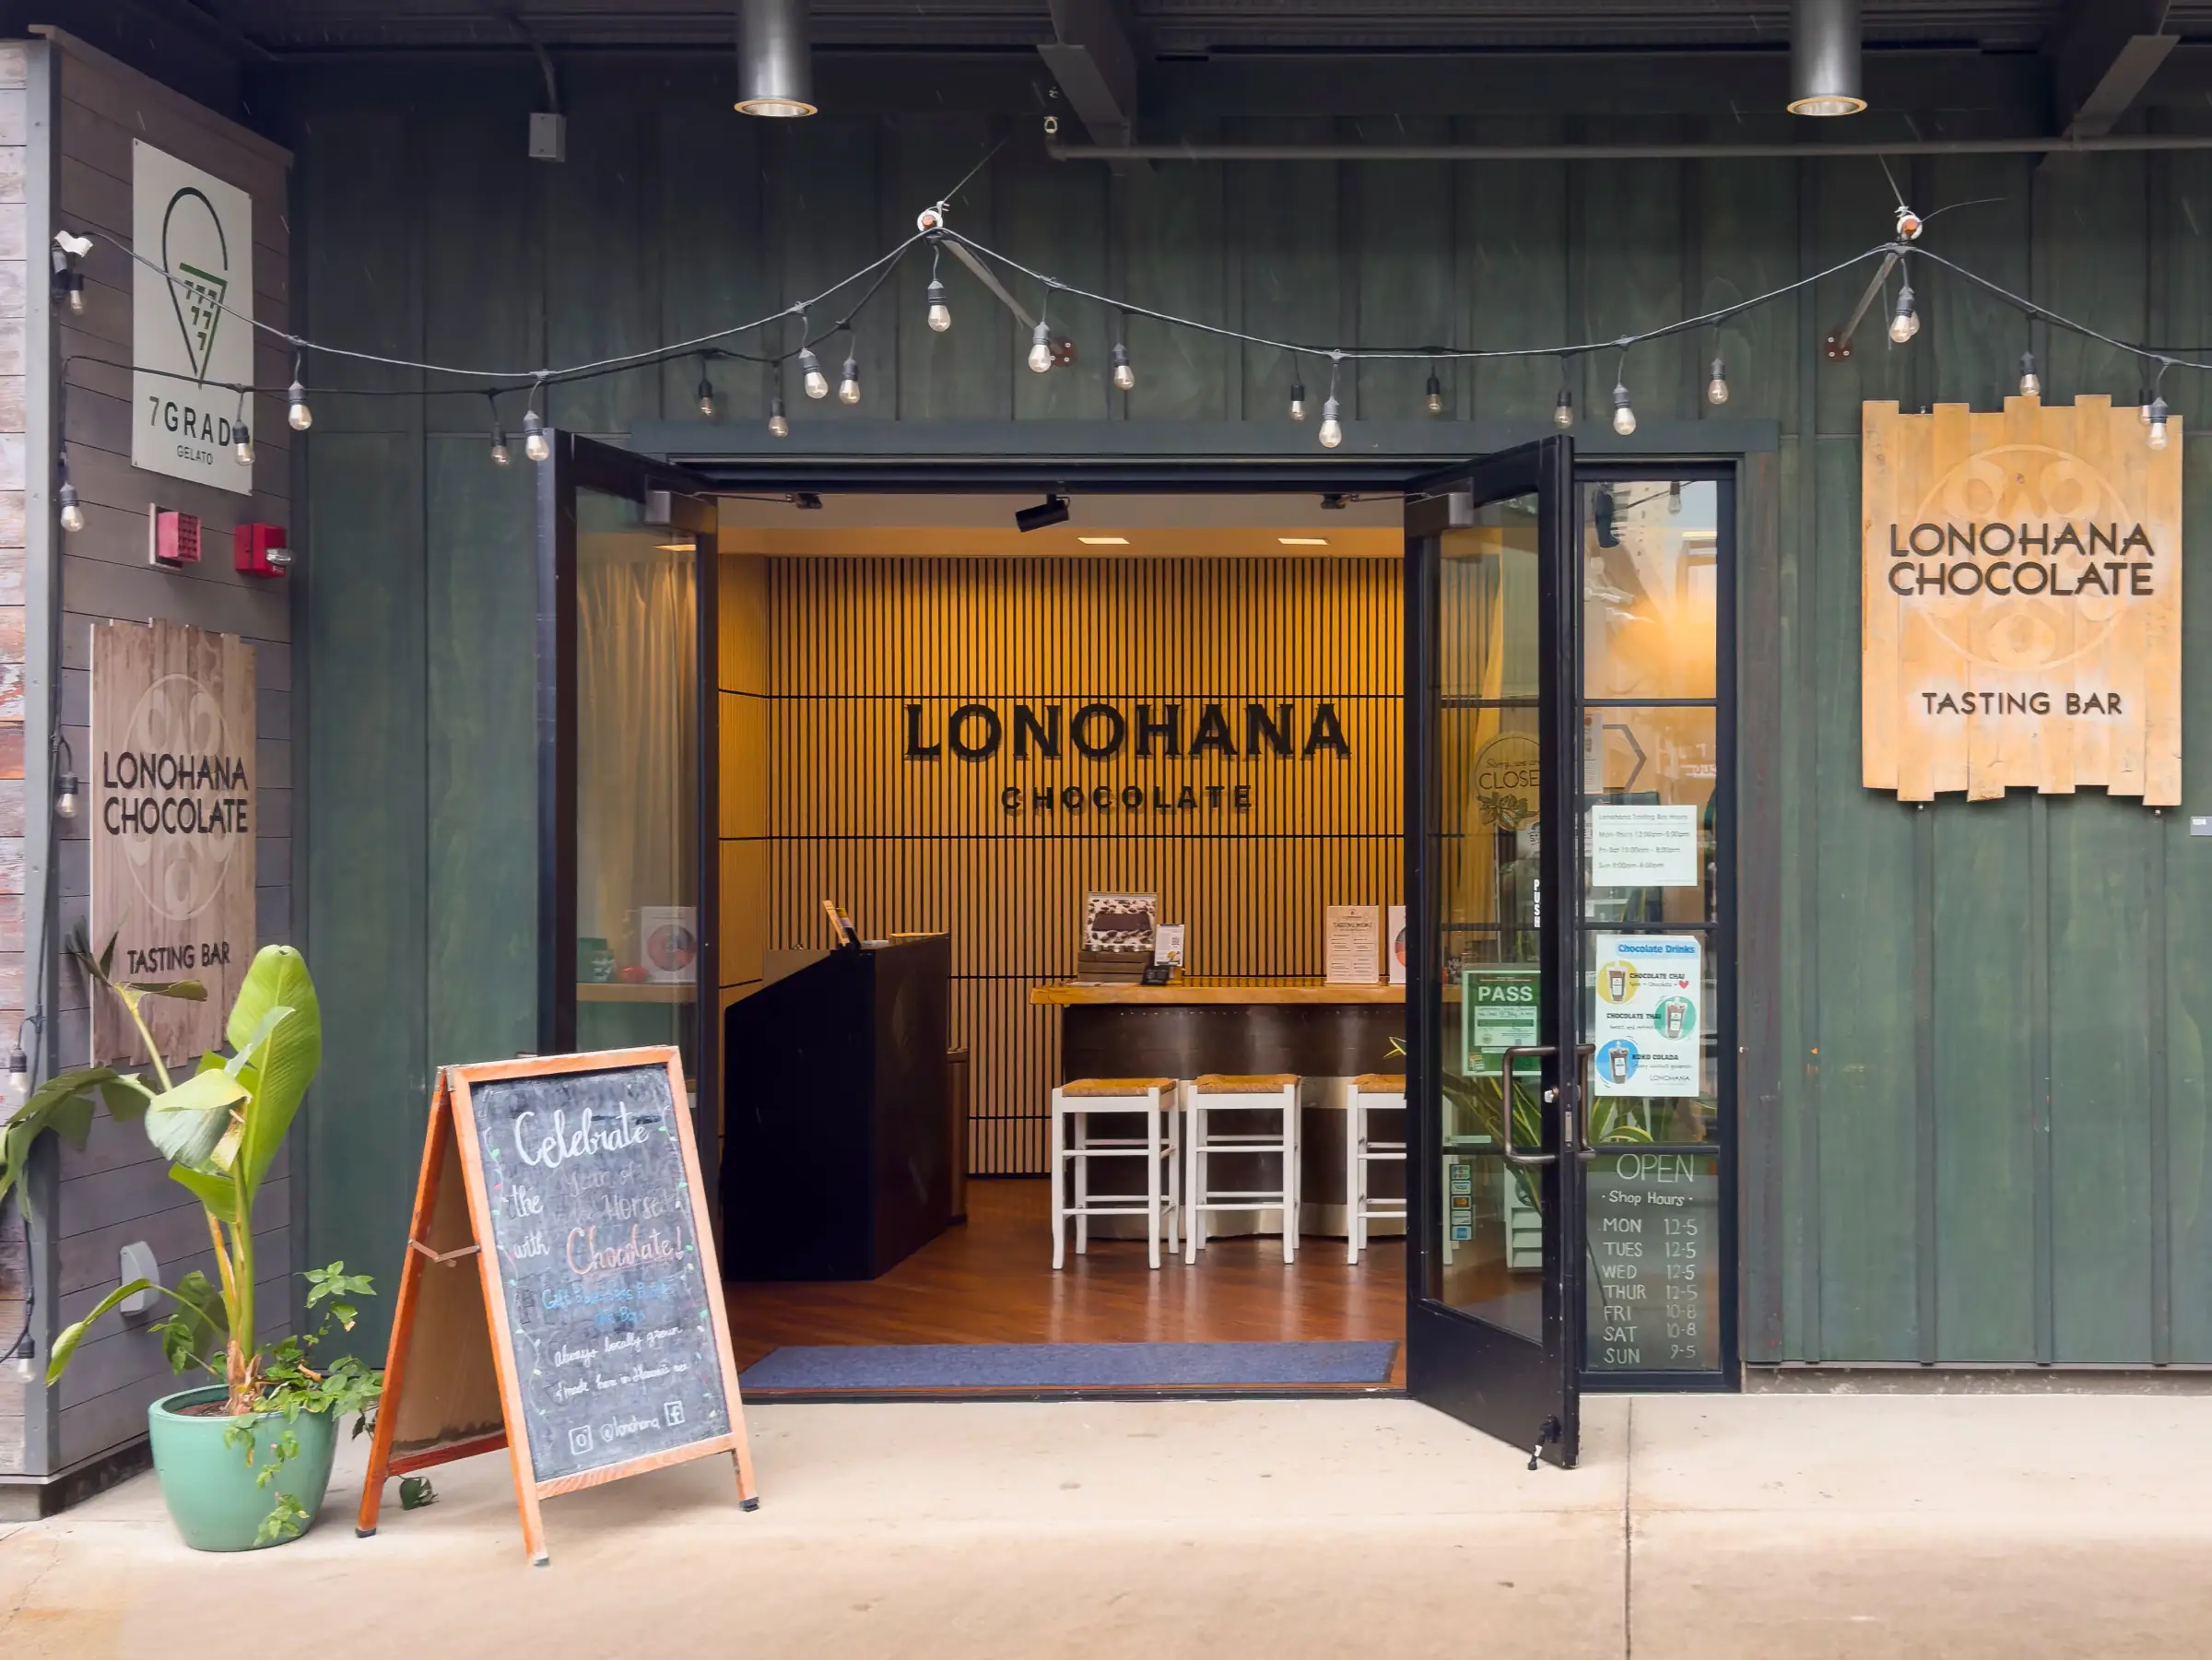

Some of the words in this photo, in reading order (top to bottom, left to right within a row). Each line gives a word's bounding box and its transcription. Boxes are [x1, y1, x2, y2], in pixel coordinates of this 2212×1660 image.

[149, 396, 231, 447] 7GRAD
[177, 445, 214, 465] GELATO
[1889, 522, 2155, 557] LONOHANA
[1888, 561, 2154, 595] CHOCOLATE
[1922, 691, 2051, 715] TASTING
[2065, 692, 2123, 714] BAR
[902, 703, 1352, 758] LONOHANA
[103, 751, 249, 791] LONOHANA
[1478, 770, 1541, 790] CLOSE
[1001, 784, 1253, 811] CHOCOLATE
[103, 796, 249, 835] CHOCOLATE
[127, 944, 195, 974] TASTING
[201, 941, 231, 967] BAR
[1618, 944, 1664, 954] Chocolate
[1665, 945, 1696, 954] Drinks
[1477, 985, 1534, 1002] PASS
[514, 1101, 650, 1169] Celebrate
[1617, 1153, 1694, 1183] OPEN
[507, 1184, 545, 1219] the
[1608, 1190, 1642, 1207] Shop
[1647, 1191, 1686, 1207] Hours
[1603, 1218, 1642, 1233] MON
[1664, 1218, 1698, 1236] 12-5
[512, 1229, 550, 1261] with
[566, 1224, 685, 1275] Chocolate!
[1603, 1242, 1642, 1257] TUES
[1664, 1242, 1697, 1259] 12-5
[1601, 1265, 1638, 1279] WED
[1666, 1264, 1696, 1280] 12-5
[1603, 1284, 1647, 1300] THUR
[1665, 1284, 1698, 1301] 12-5
[1604, 1305, 1631, 1323] FRI
[1665, 1303, 1697, 1319] 10-8
[604, 1333, 644, 1352] locally
[1603, 1326, 1638, 1343] SAT
[1666, 1322, 1697, 1338] 10-8
[1604, 1348, 1641, 1364] SUN
[1670, 1344, 1696, 1360] 9-5
